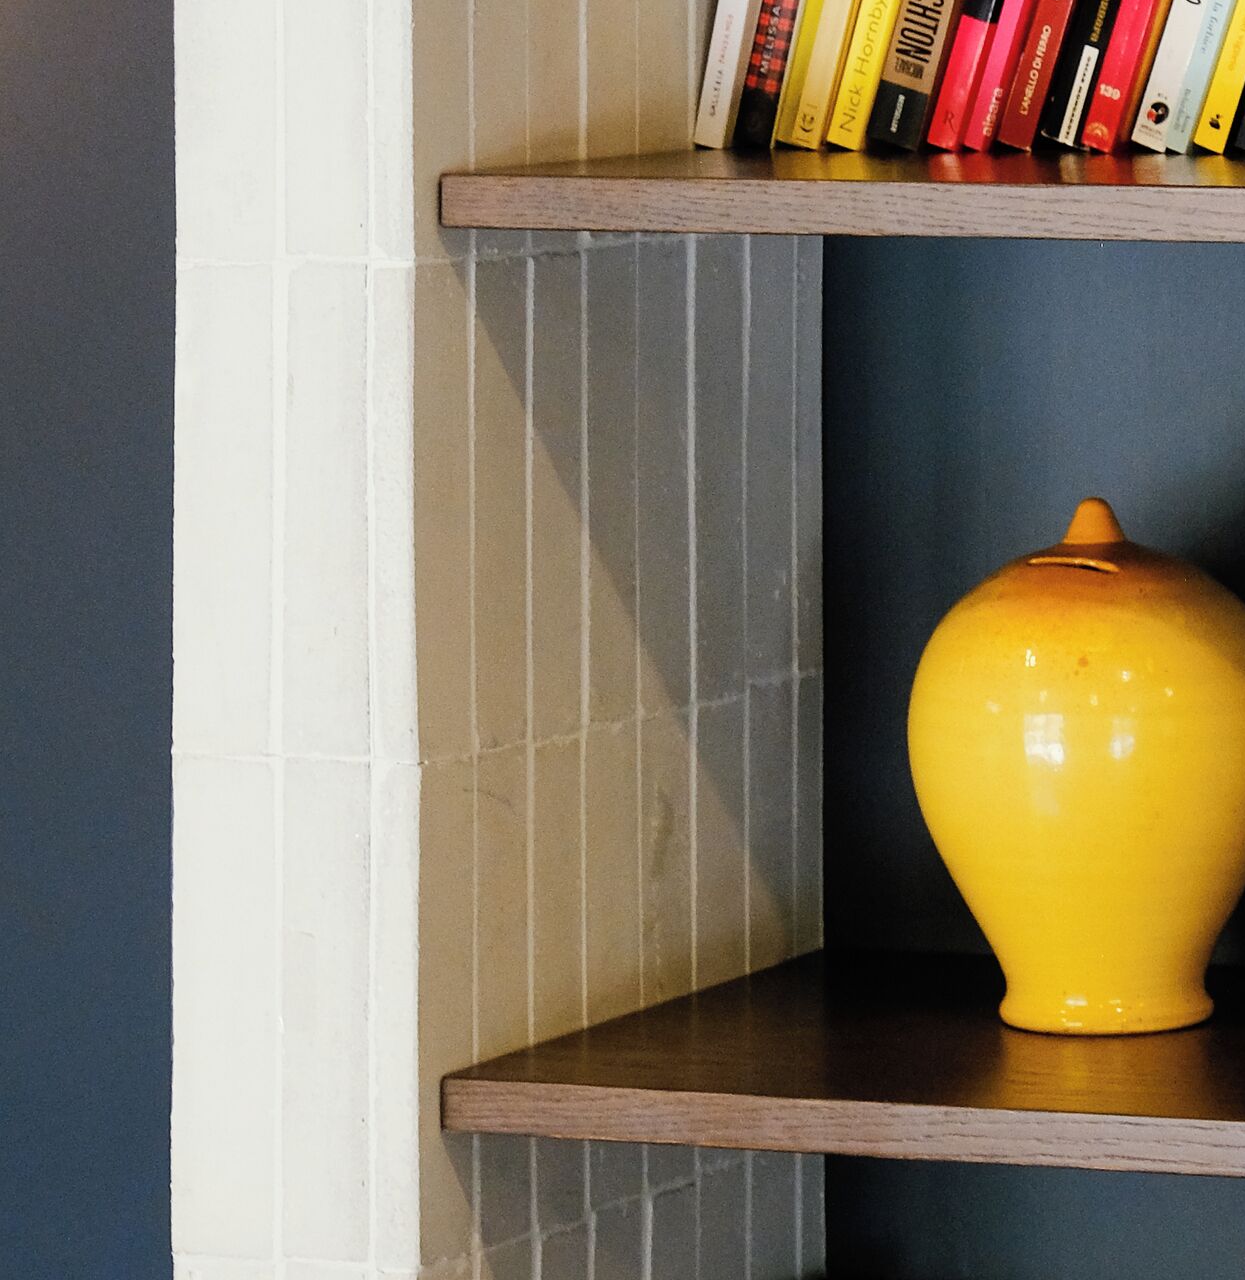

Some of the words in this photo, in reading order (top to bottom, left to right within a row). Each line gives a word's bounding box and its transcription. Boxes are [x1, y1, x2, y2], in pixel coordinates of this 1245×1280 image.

[758, 4, 781, 74] MELISSA
[1032, 54, 1042, 69] DI
[838, 85, 862, 132] Nick
